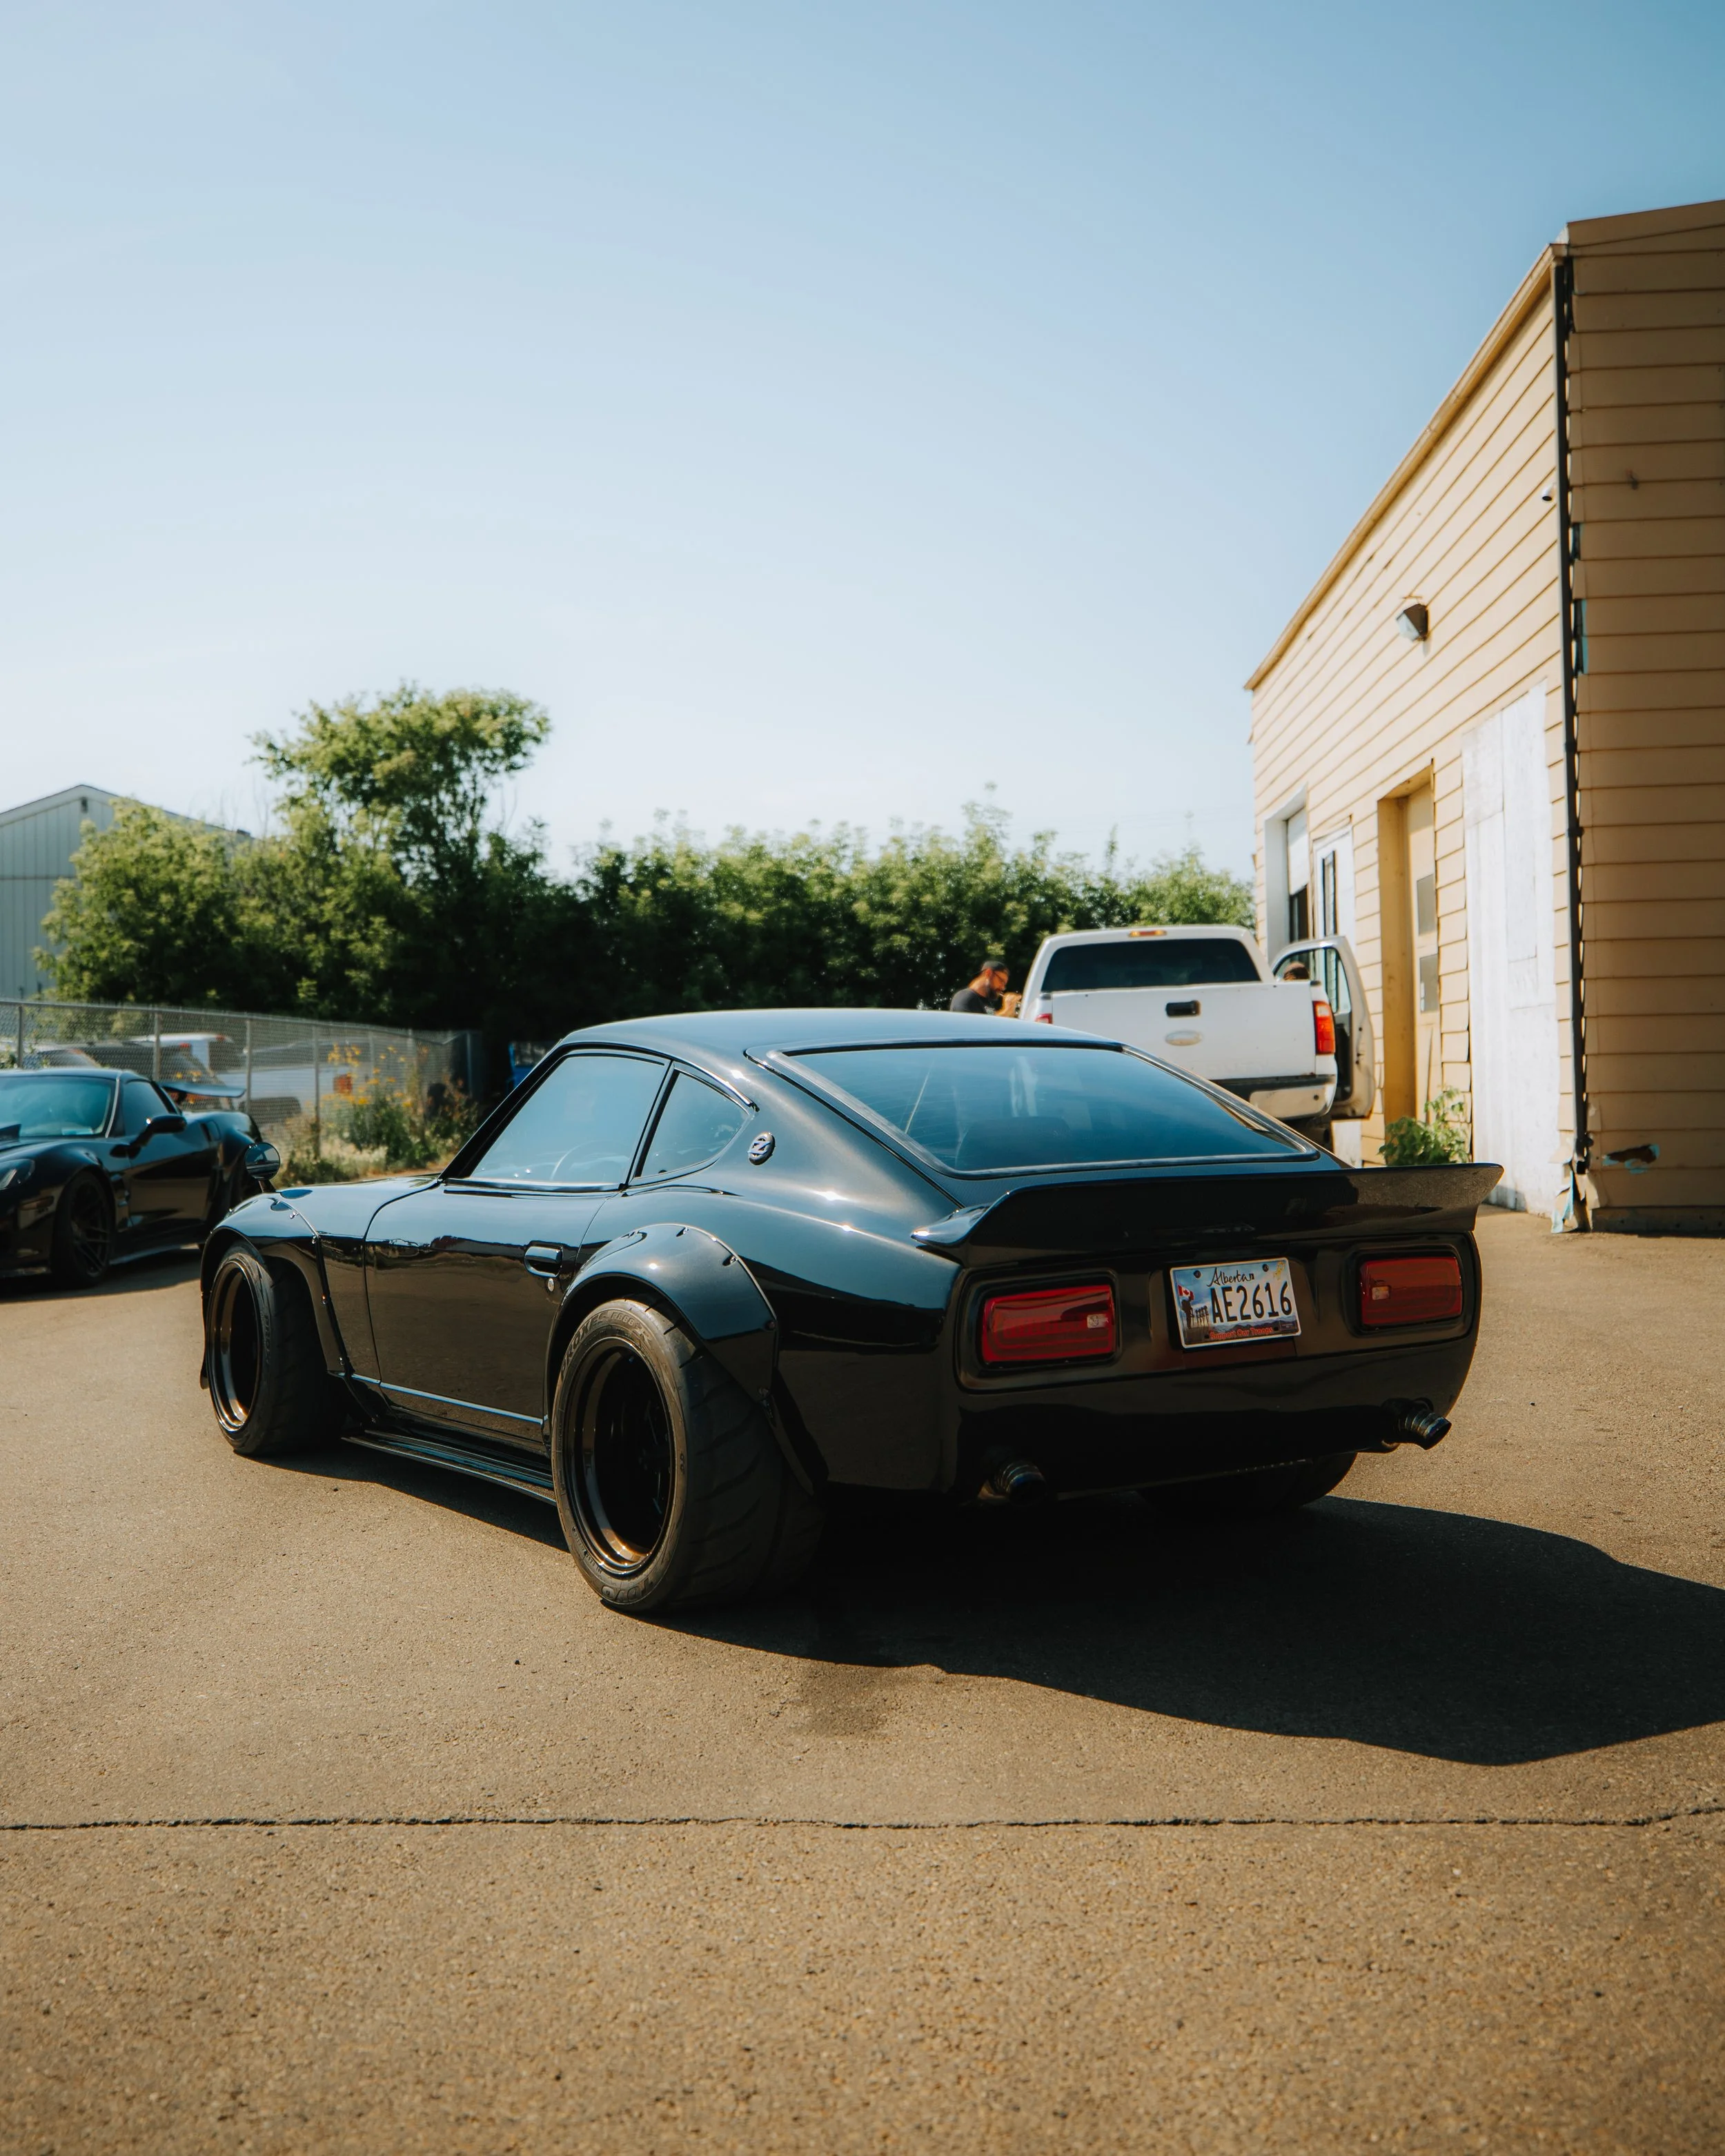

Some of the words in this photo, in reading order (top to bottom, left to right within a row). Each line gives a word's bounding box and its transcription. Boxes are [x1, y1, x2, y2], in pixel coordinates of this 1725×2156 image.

[1207, 1267, 1251, 1287] Alberta
[1210, 1281, 1292, 1323] AE2616
[1210, 1330, 1236, 1341] Support
[1236, 1328, 1250, 1336] Our
[1250, 1327, 1274, 1336] Troops
